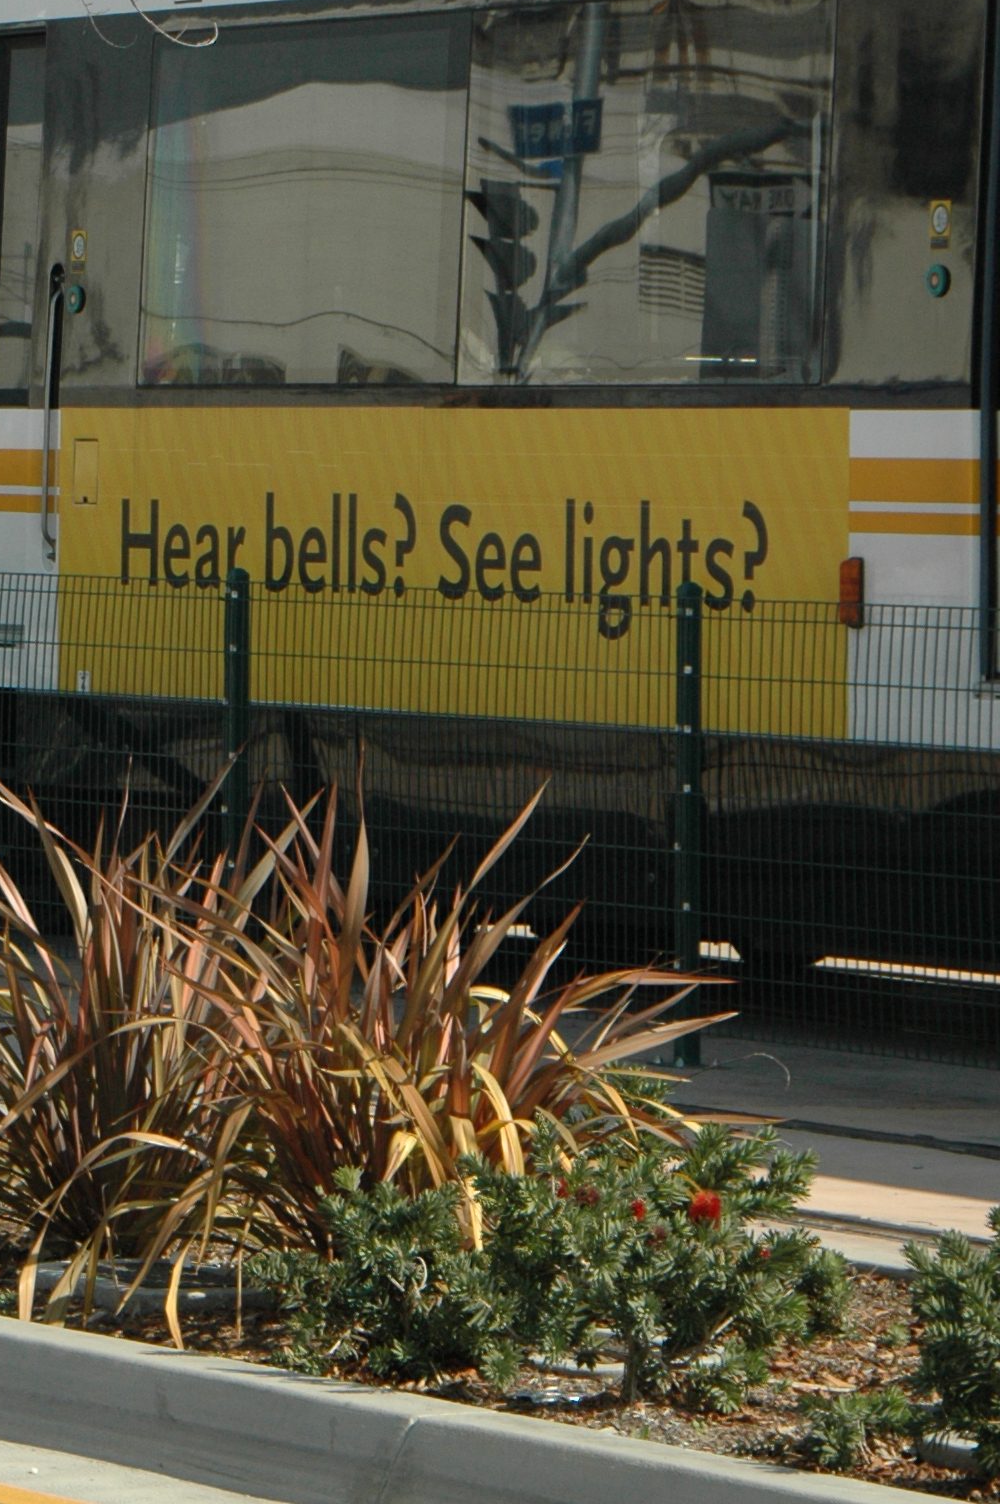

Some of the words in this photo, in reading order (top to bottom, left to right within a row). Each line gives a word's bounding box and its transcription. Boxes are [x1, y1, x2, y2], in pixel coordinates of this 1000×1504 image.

[121, 498, 246, 589] Hear
[265, 492, 416, 597] bells?
[438, 504, 542, 603] See
[564, 498, 768, 640] lights?
